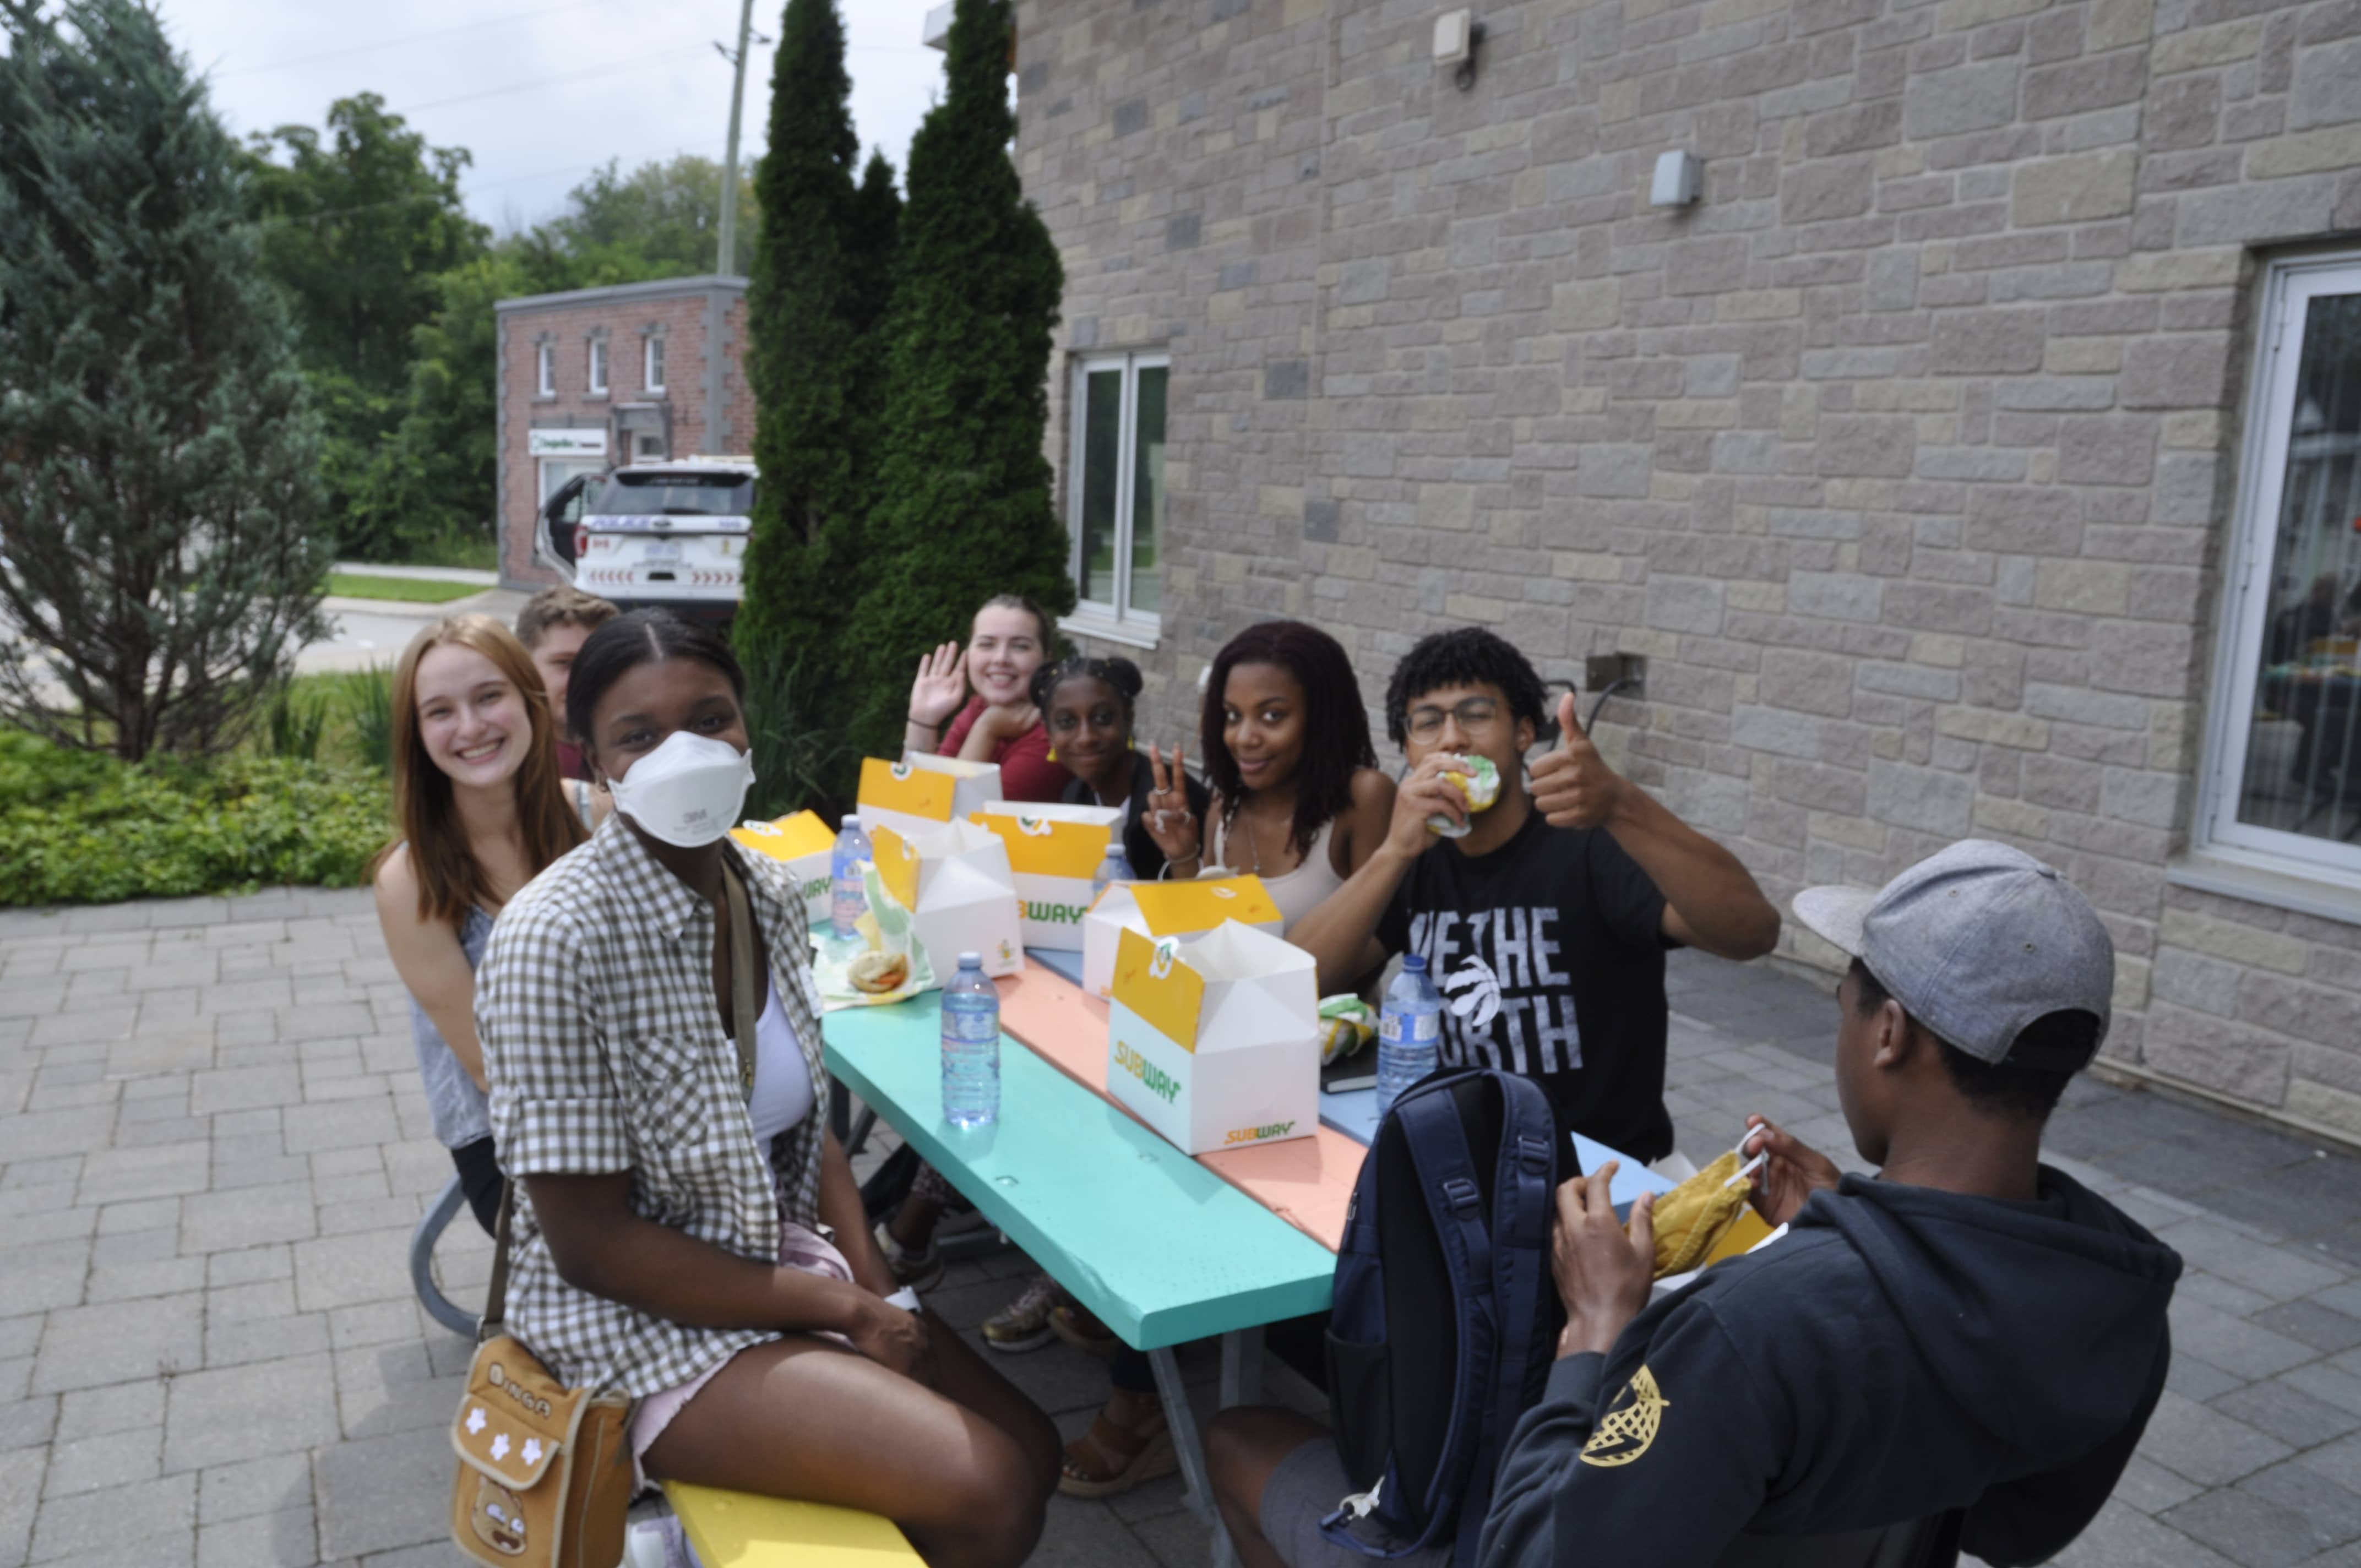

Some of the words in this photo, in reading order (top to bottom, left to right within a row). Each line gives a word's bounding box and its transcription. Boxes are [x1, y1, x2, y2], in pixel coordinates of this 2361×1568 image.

[1467, 907, 1571, 989] THE
[1438, 994, 1584, 1074] ORTH
[1114, 1041, 1181, 1104] SUBWAY
[1224, 1120, 1296, 1145] SUBWAY
